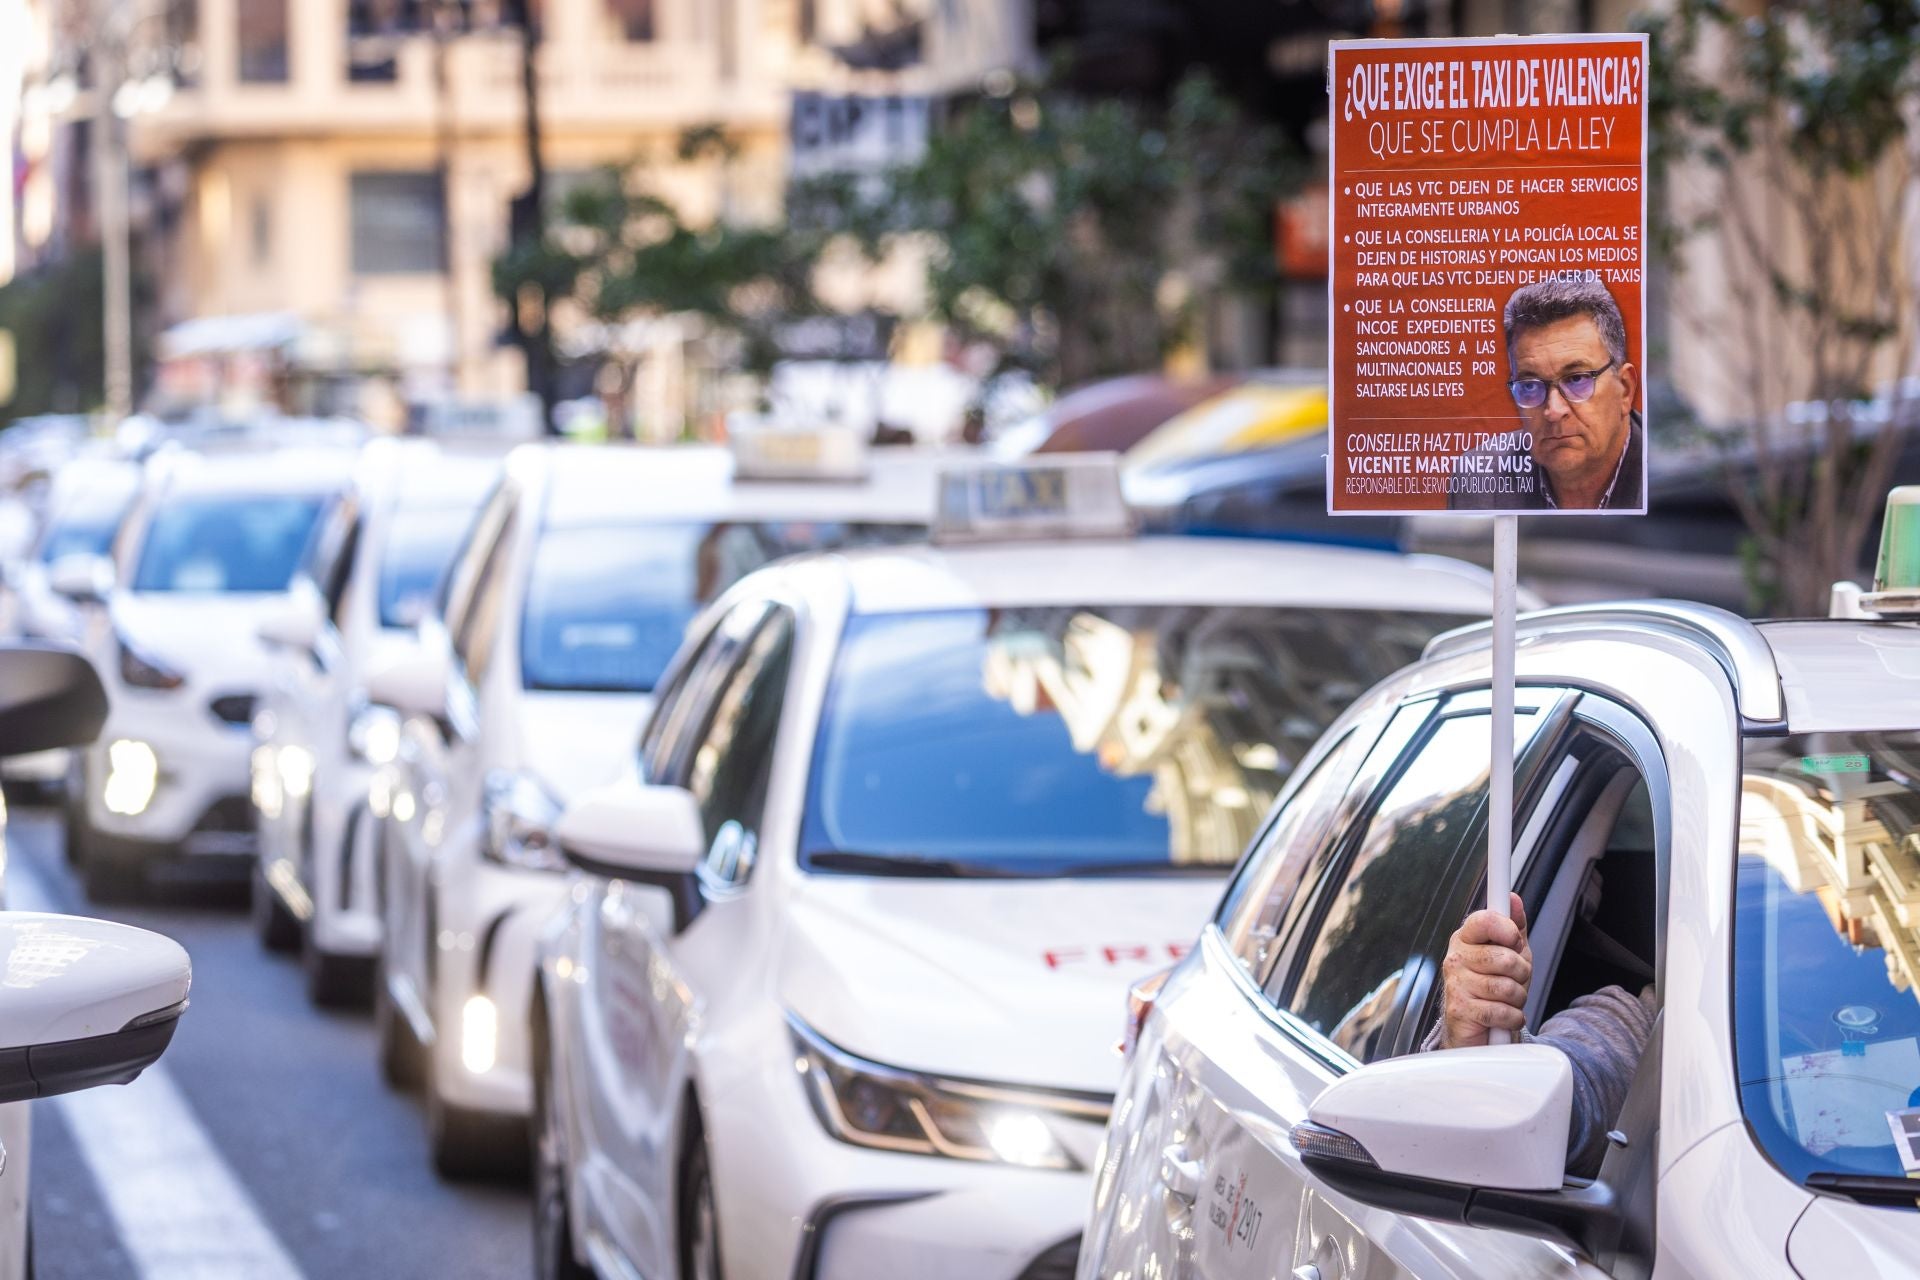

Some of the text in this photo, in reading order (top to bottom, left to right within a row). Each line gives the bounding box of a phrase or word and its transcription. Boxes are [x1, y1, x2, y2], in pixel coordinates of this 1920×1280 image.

[1344, 57, 1640, 121] ¿QUE EXIGE EL TAXI DE VALENCIA?
[1369, 117, 1616, 161] QUE SE CUMPLA LA LEY
[1356, 177, 1638, 198] QUE LAS VTC DEJEN DE HACER SERVICIOS
[1357, 201, 1520, 218] INTEGRAMENTE URBANOS
[1355, 224, 1638, 247] QUE LA CONSELLERIA Y LA POLICÍA LOCAL SE
[1357, 247, 1638, 266] DEJEN DE HISTORIAS Y PONGAN LOS MEDIOS
[1357, 268, 1641, 288] PARA QUE LAS VTC DEJEN DE HACER DE TAXIS
[1355, 298, 1496, 317] QUE LA CONSELLERIA
[1357, 320, 1496, 335] INCOE EXPEDIENTES
[1356, 341, 1496, 356] SANCIONADORES A LAS
[1357, 362, 1496, 377] MULTINACIONALES POR
[1356, 382, 1464, 398] SALTARSE LAS LEYES
[1347, 432, 1533, 452] CONSELLER HAZ TU TRABAJO
[1348, 456, 1533, 474] VICENTE MARTINEZ MUS
[1346, 473, 1534, 494] RESPONSABLE DEL SERVICIO PÚBLICO DEL TAXI
[1237, 1198, 1263, 1251] 2917
